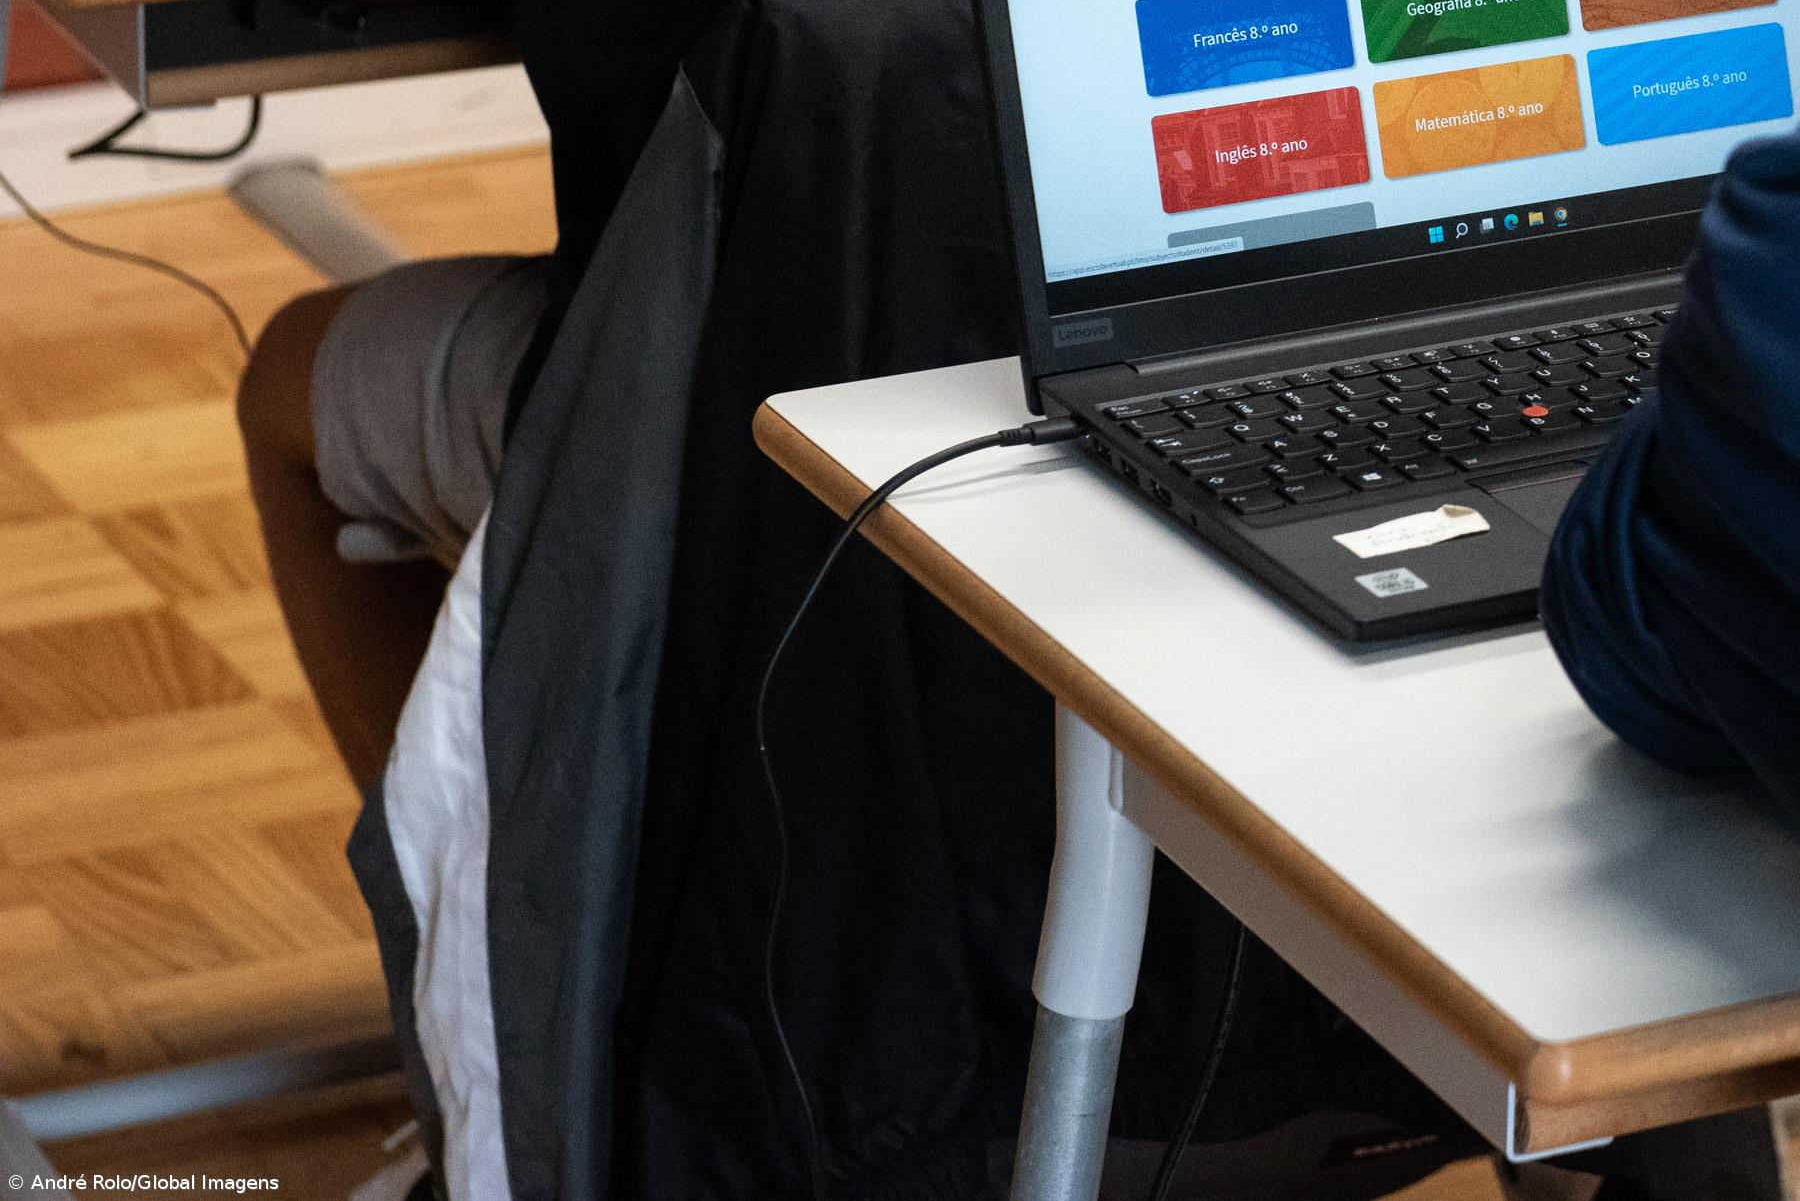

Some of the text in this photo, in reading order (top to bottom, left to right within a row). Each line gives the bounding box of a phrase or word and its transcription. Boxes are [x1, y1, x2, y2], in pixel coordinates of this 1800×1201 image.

[1193, 22, 1298, 48] Francês 8.º ano
[1632, 69, 1747, 100] Português 8.º ano
[1415, 101, 1544, 133] Matemática 8.º ano
[1215, 138, 1308, 165] Inglês 8.º ano
[1057, 324, 1108, 343] Lenovo
